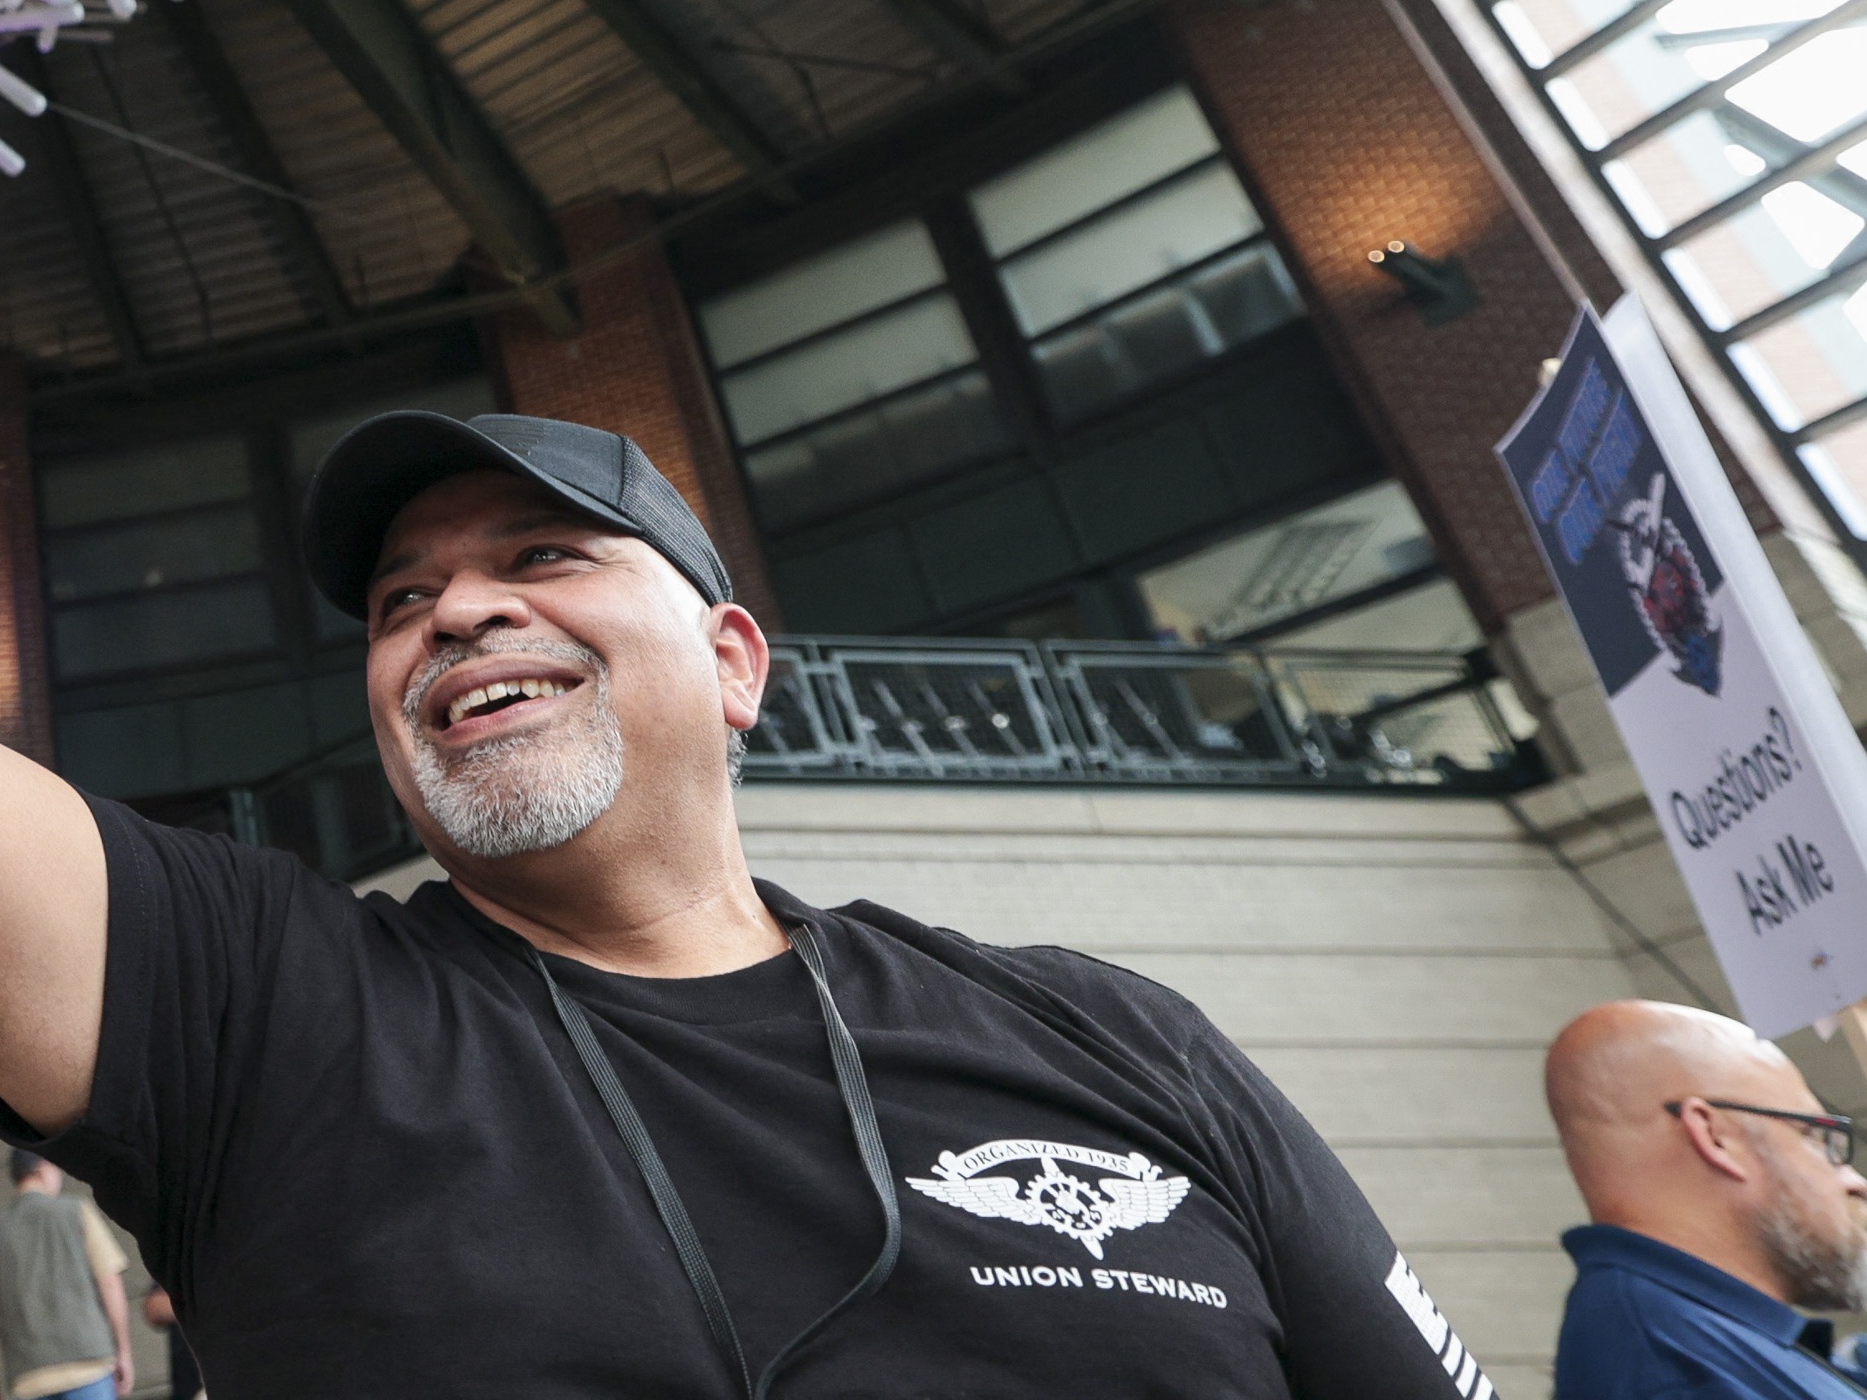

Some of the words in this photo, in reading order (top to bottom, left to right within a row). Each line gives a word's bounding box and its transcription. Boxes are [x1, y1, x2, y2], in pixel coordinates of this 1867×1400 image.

[1671, 706, 1803, 850] Questions?
[1736, 855, 1798, 937] Ask
[1777, 835, 1834, 908] Me
[963, 1142, 1079, 1170] ORGANIZED
[1087, 1153, 1129, 1172] 1935
[970, 1266, 1083, 1287] UNION
[1091, 1268, 1227, 1309] STEWARD
